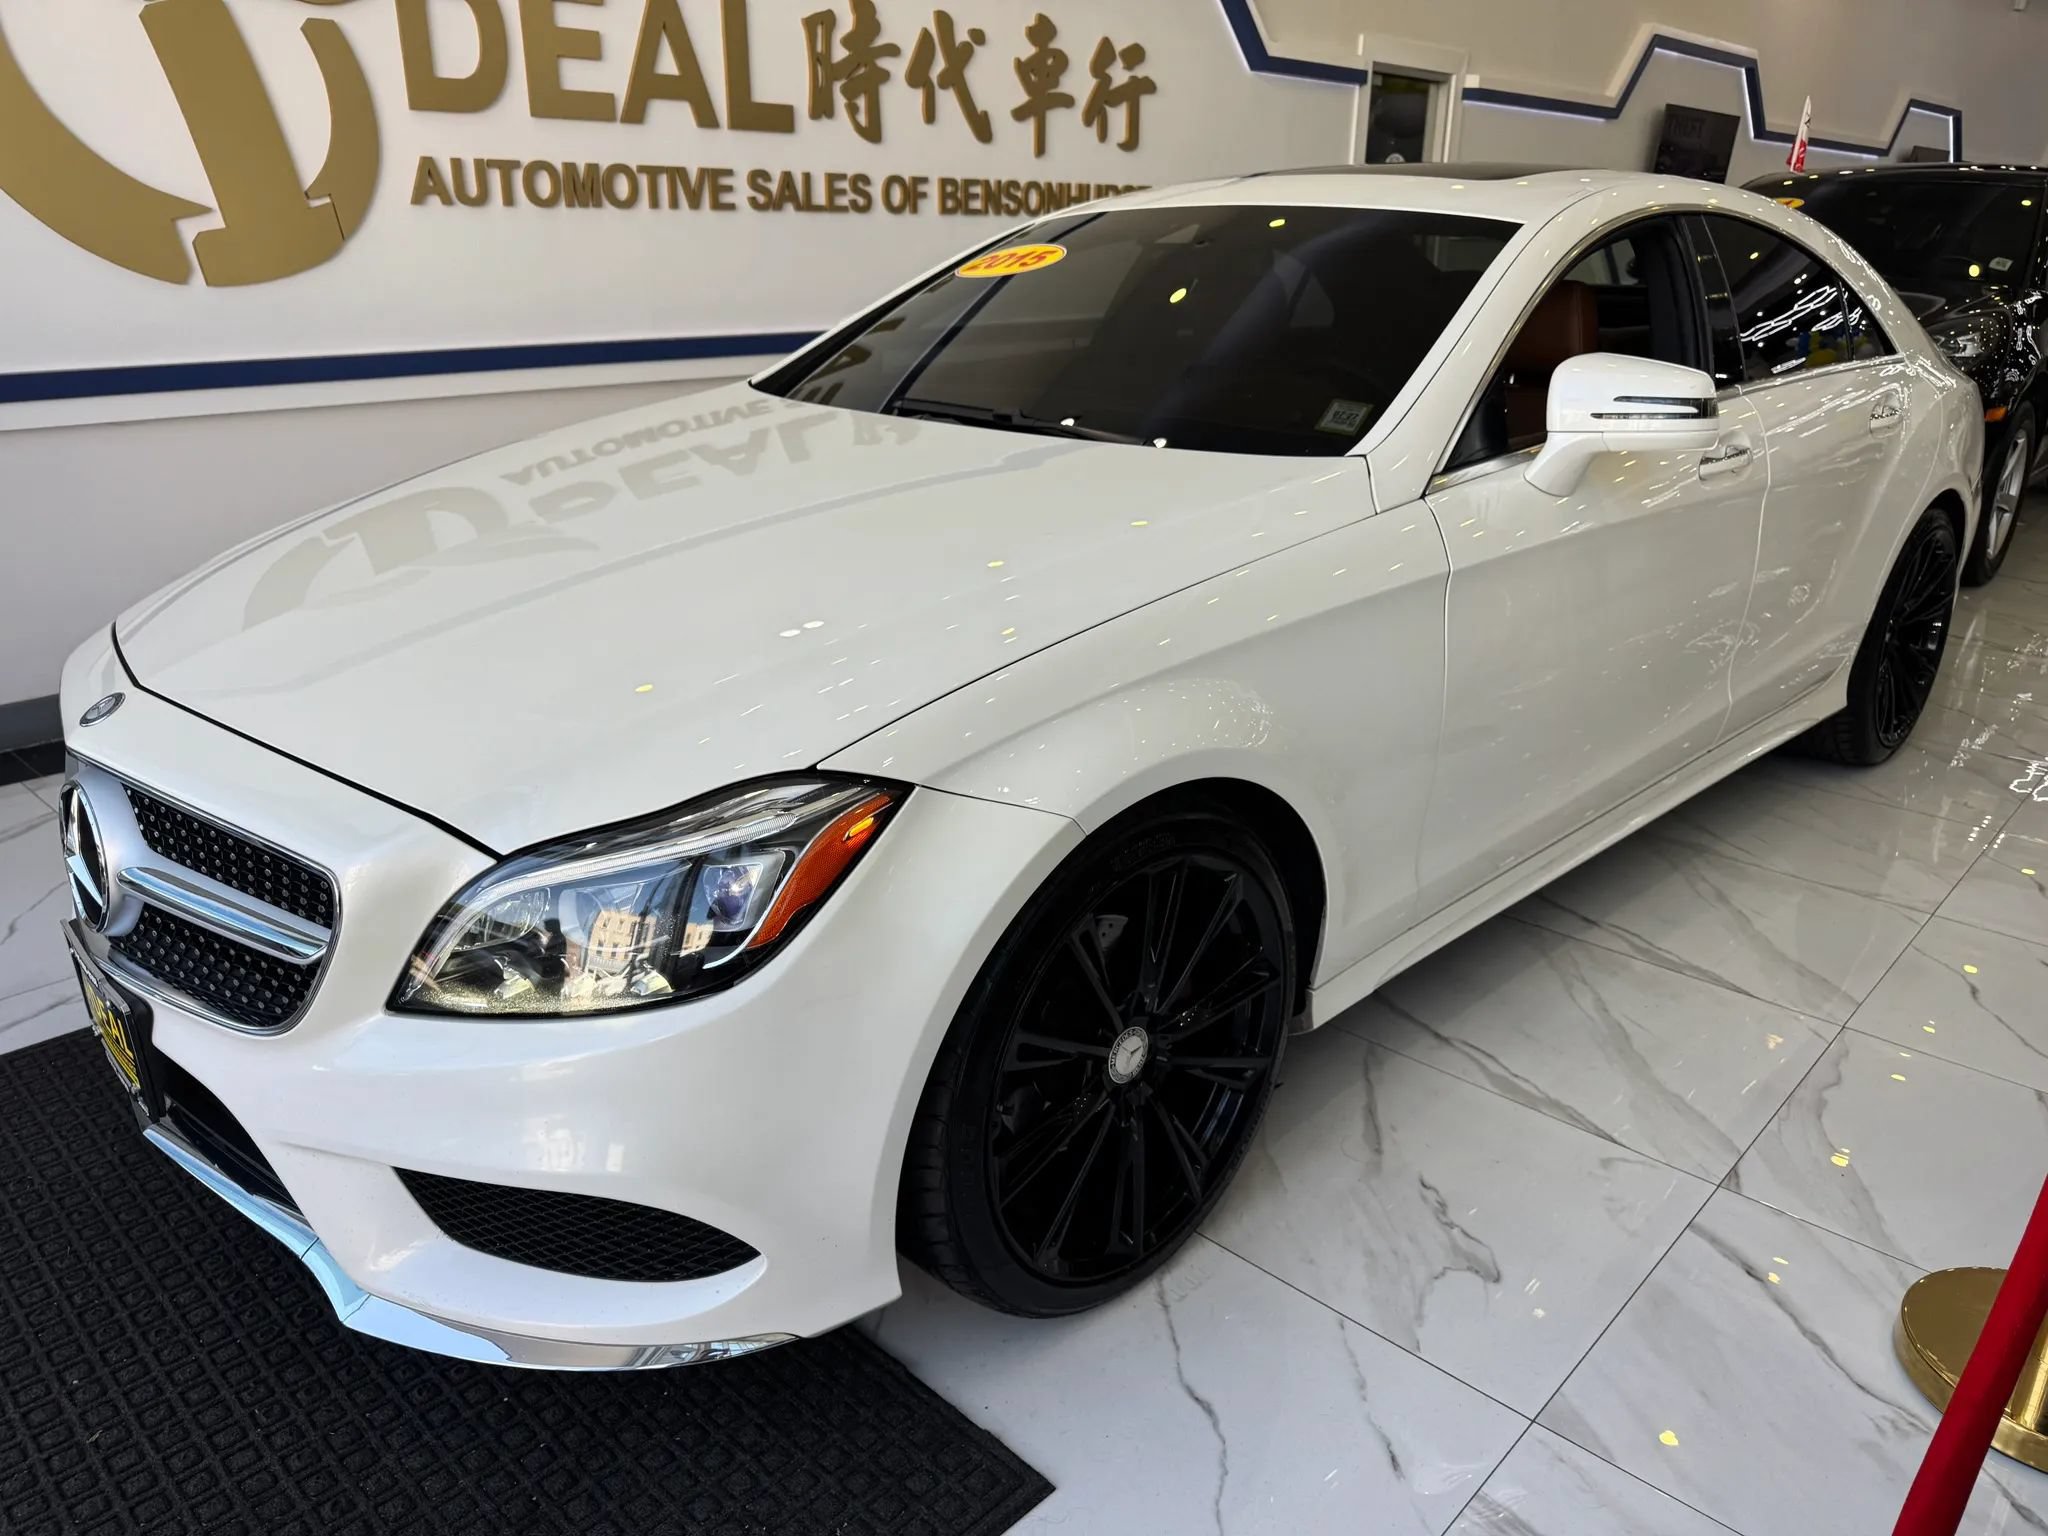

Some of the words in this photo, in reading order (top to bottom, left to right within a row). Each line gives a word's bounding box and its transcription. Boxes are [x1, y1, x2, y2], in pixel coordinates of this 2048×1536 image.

[801, 0, 1157, 158] 時代車行
[411, 155, 737, 212] AUTOMOTIVE
[746, 169, 873, 214] SALES
[882, 174, 930, 215] OF
[938, 176, 1153, 217] BENSONH
[961, 250, 1058, 272] 2015
